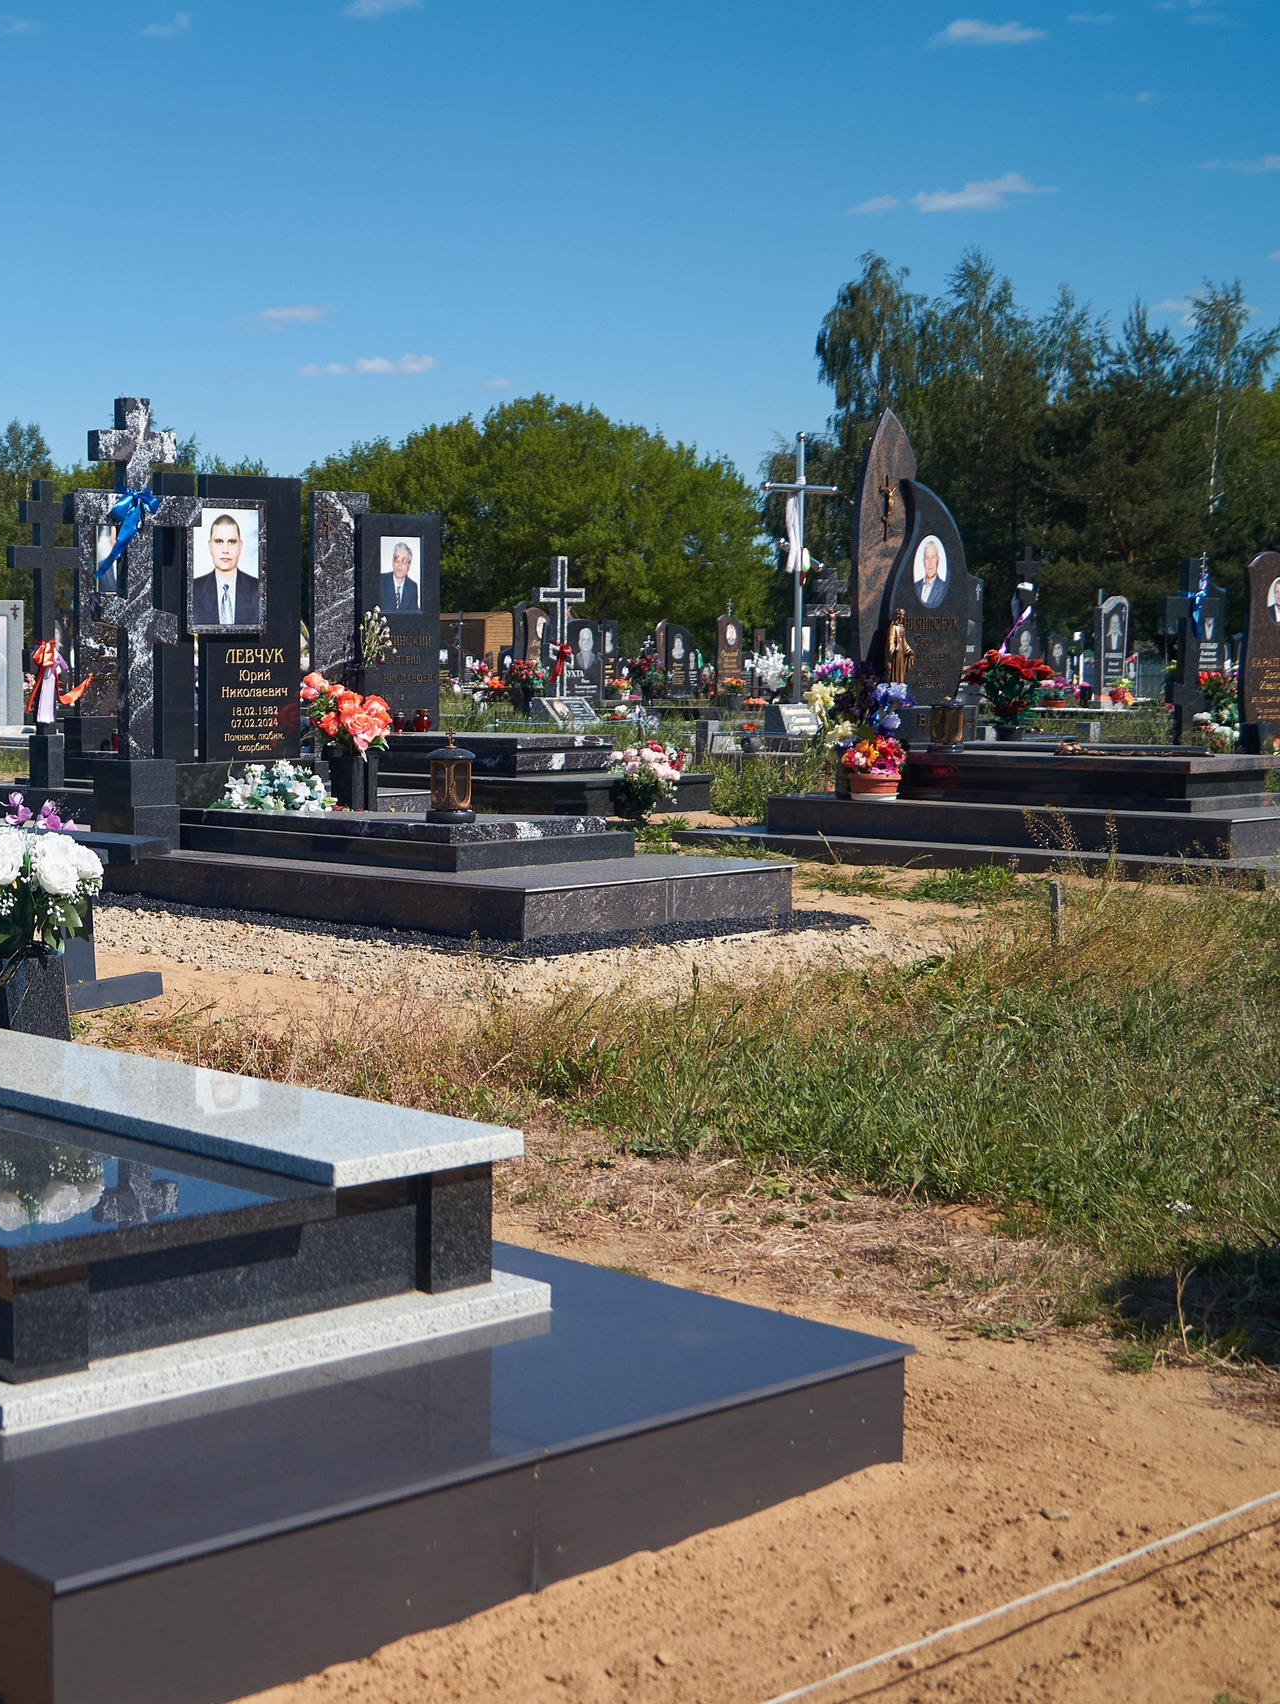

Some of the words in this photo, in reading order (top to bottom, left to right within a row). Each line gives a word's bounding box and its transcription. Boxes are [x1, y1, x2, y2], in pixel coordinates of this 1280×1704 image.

[225, 648, 285, 664] ЛЕВЧУК
[239, 668, 271, 684] Юрий
[221, 686, 289, 698] Николаевич
[232, 705, 279, 716] 18.02.1982
[230, 717, 279, 728] 07.02.2024
